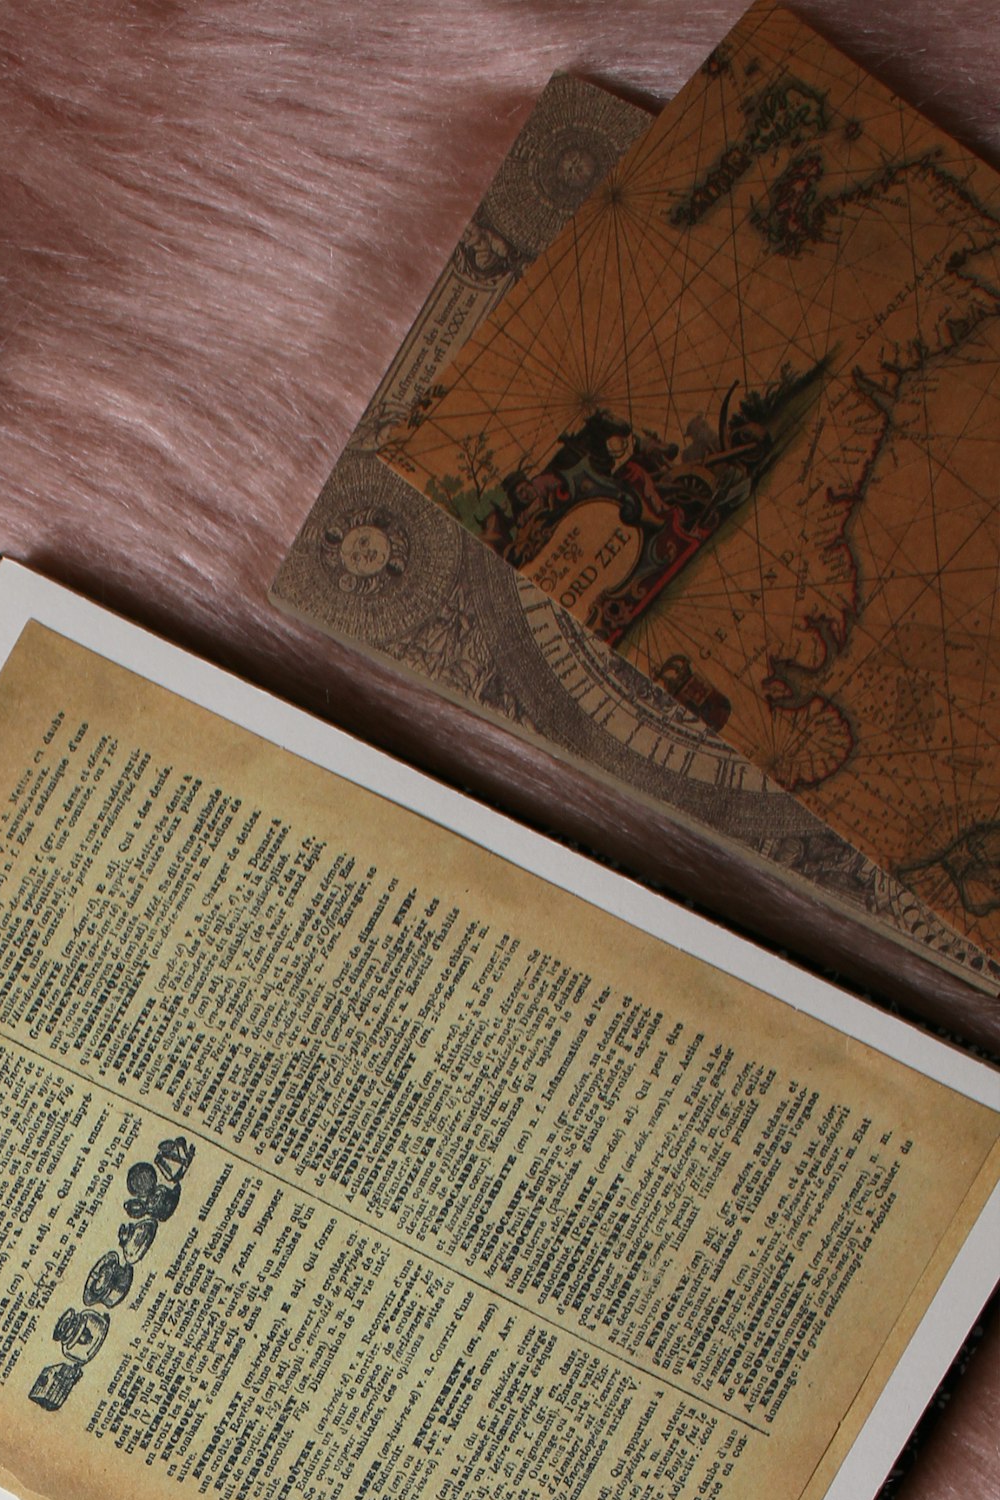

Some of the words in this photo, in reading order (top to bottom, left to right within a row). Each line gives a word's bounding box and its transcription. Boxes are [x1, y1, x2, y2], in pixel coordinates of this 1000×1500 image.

[528, 524, 581, 585] ascaarte
[592, 525, 632, 569] ZEE
[192, 788, 222, 835] méthode
[108, 857, 134, 898] appétit.
[258, 825, 292, 873] tristesse.
[319, 852, 348, 892] démon.
[22, 868, 49, 912] spéciale
[248, 853, 291, 918] indiscipliné.
[316, 881, 357, 948] d'Offenbach.
[92, 959, 151, 1061] ENDETTEMENT
[208, 815, 234, 852] Action
[132, 995, 184, 1081] ENDEUILLER
[247, 826, 276, 869] Donner
[348, 937, 380, 985] diamant.
[112, 997, 157, 1071] ENDETTER
[227, 1051, 275, 1129] ENDIABLER
[337, 881, 372, 929] Enrager,
[519, 980, 549, 1027] Disposer
[289, 1088, 333, 1162] ENDIGUER
[377, 940, 415, 1000] Renfermer
[329, 1130, 362, 1182] ENDIVE
[449, 920, 480, 968] chicorée.
[374, 1018, 412, 1077] dimanches.
[269, 1053, 327, 1151] ENDIGUEMENT
[309, 1074, 368, 1171] ENDIMANCHER
[683, 1076, 707, 1107] Faire
[35, 1108, 74, 1173] embrouillée.
[460, 1154, 517, 1252] ENDOCARDITE
[541, 1028, 588, 1102] Inflammation
[525, 1144, 563, 1202] Membrane
[197, 1163, 234, 1222] alimentant
[429, 1153, 479, 1236] ENDOCARDE
[479, 1179, 529, 1263] ENDOCARPE
[231, 1241, 257, 1277] Techn.
[252, 1188, 284, 1237] Disposer
[500, 1194, 548, 1274] ENDOCRINE
[530, 1175, 598, 1290] ENDOCTRINABLE
[550, 1173, 625, 1303] ENDOCTRINEMENT
[34, 1280, 58, 1311] Table
[644, 1274, 691, 1350] ENDOGÈNE
[717, 1248, 795, 1392] ENDOLORISSEMENT
[191, 1390, 244, 1480] ENCROÛTANT
[313, 1218, 338, 1251] forme
[307, 1331, 347, 1393] Diminution
[429, 1320, 458, 1363] Couvrir
[686, 1288, 736, 1371] ENDOLORIR
[738, 1270, 811, 1401] ENDOMMAGEMENT
[758, 1307, 818, 1408] ENDOMMAGER
[109, 1375, 146, 1435] ENCRINE
[411, 1357, 466, 1449] ENCUVEMENT
[555, 1349, 590, 1405] Ensemble
[176, 1412, 208, 1457] tombant,
[447, 1393, 474, 1431] Mettre
[624, 1400, 659, 1457] appartient
